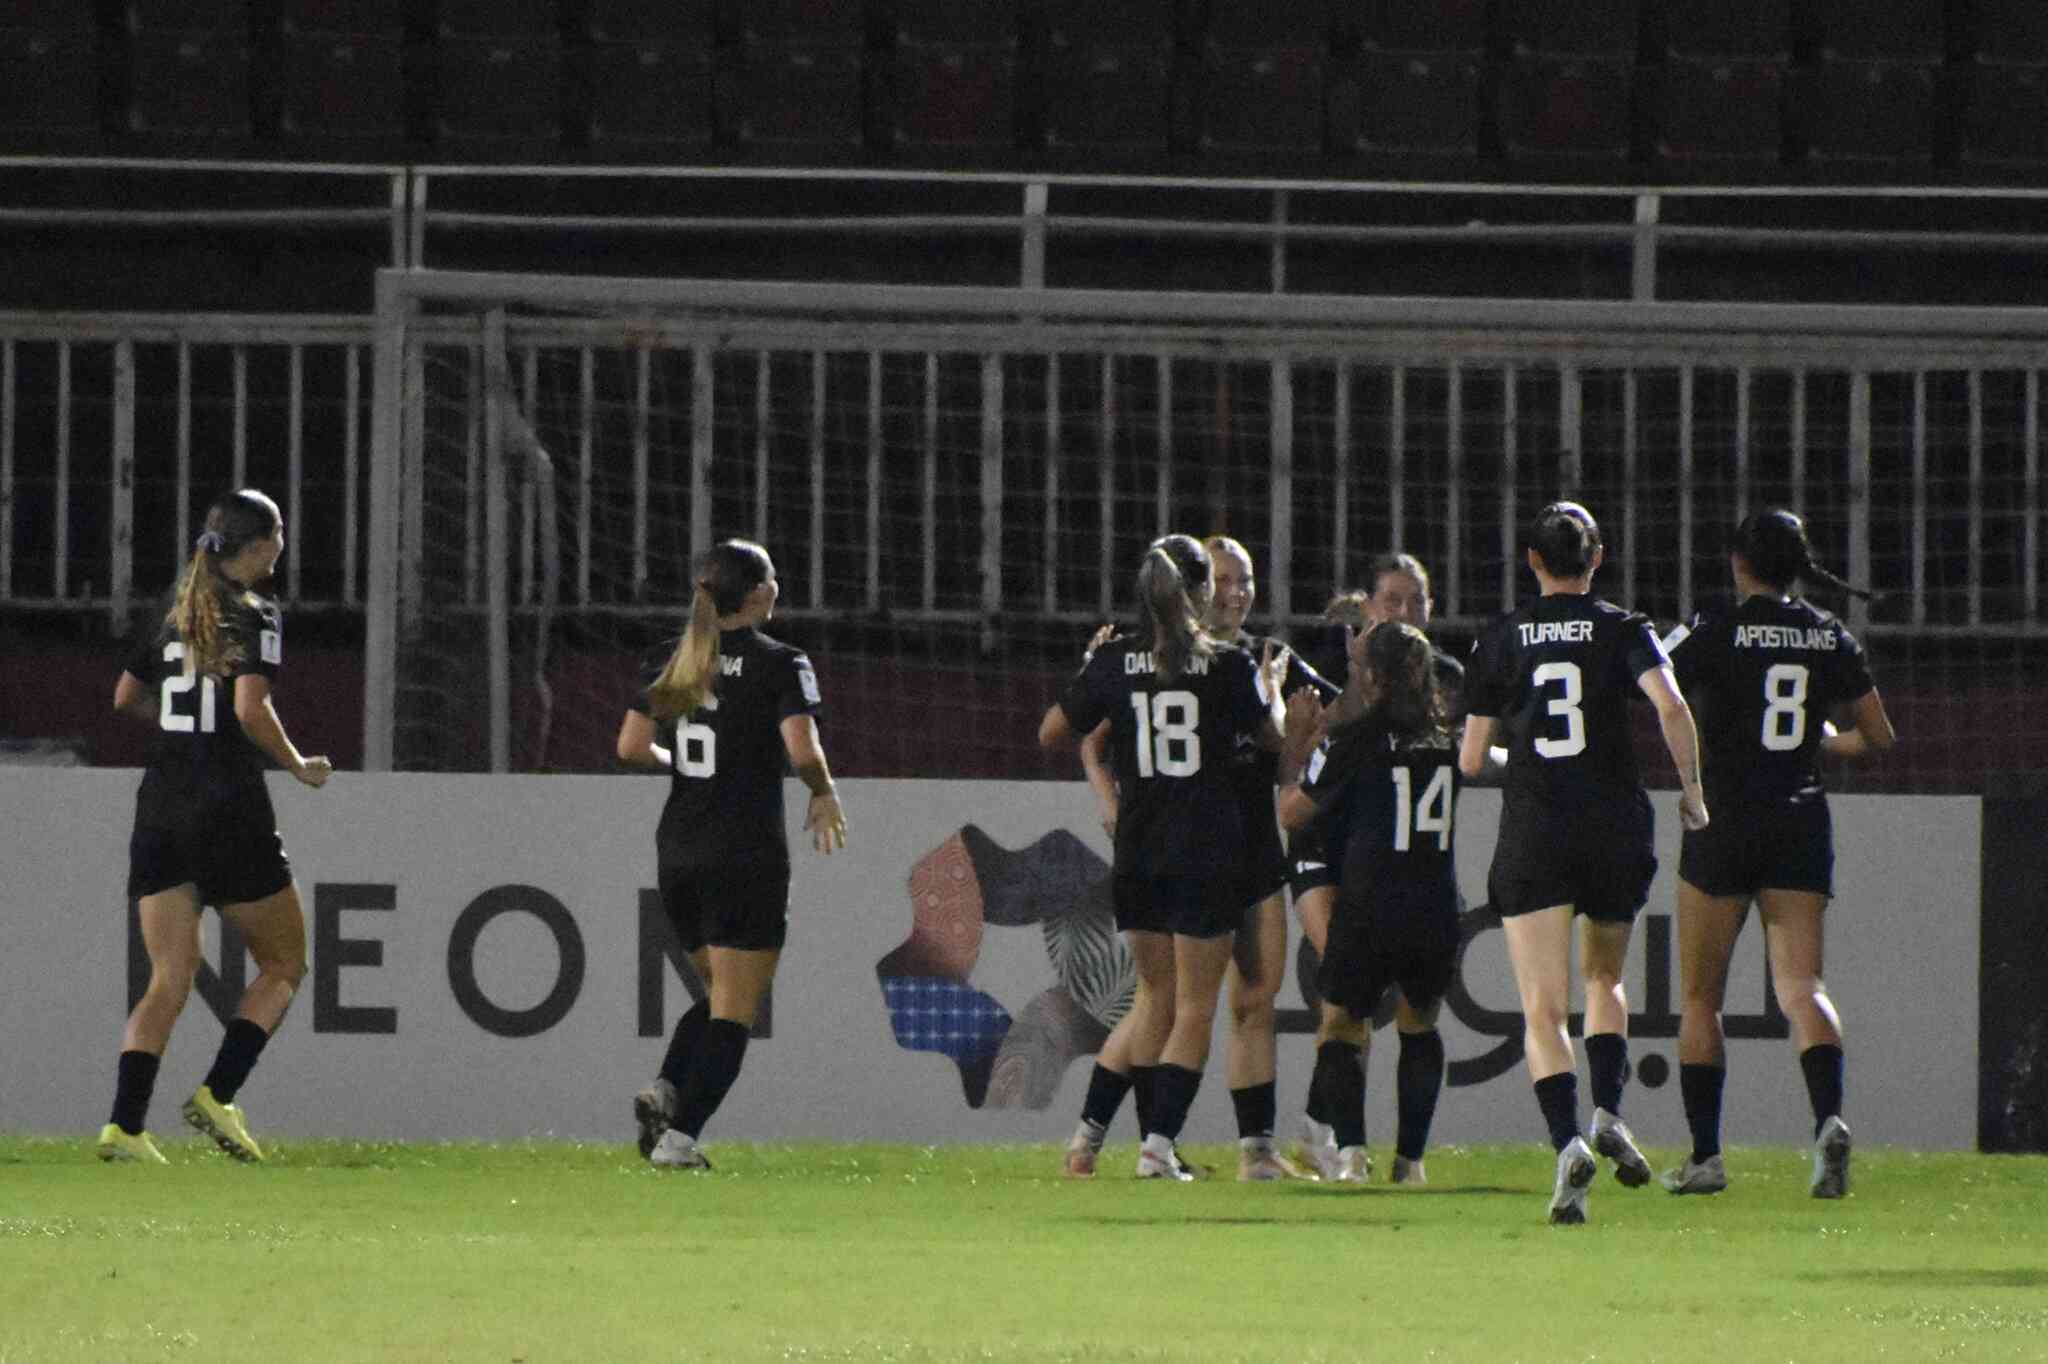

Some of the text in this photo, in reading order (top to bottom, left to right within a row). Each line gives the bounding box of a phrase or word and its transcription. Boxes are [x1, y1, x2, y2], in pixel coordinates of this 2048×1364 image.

[1518, 620, 1593, 647] TURNER
[1734, 624, 1838, 651] APOSTOLAKIS
[160, 641, 216, 733] 21
[1533, 661, 1587, 759] 3
[1761, 663, 1809, 751] 8
[676, 690, 720, 779] 6
[1130, 690, 1200, 779] 18
[1392, 765, 1453, 851] 14
